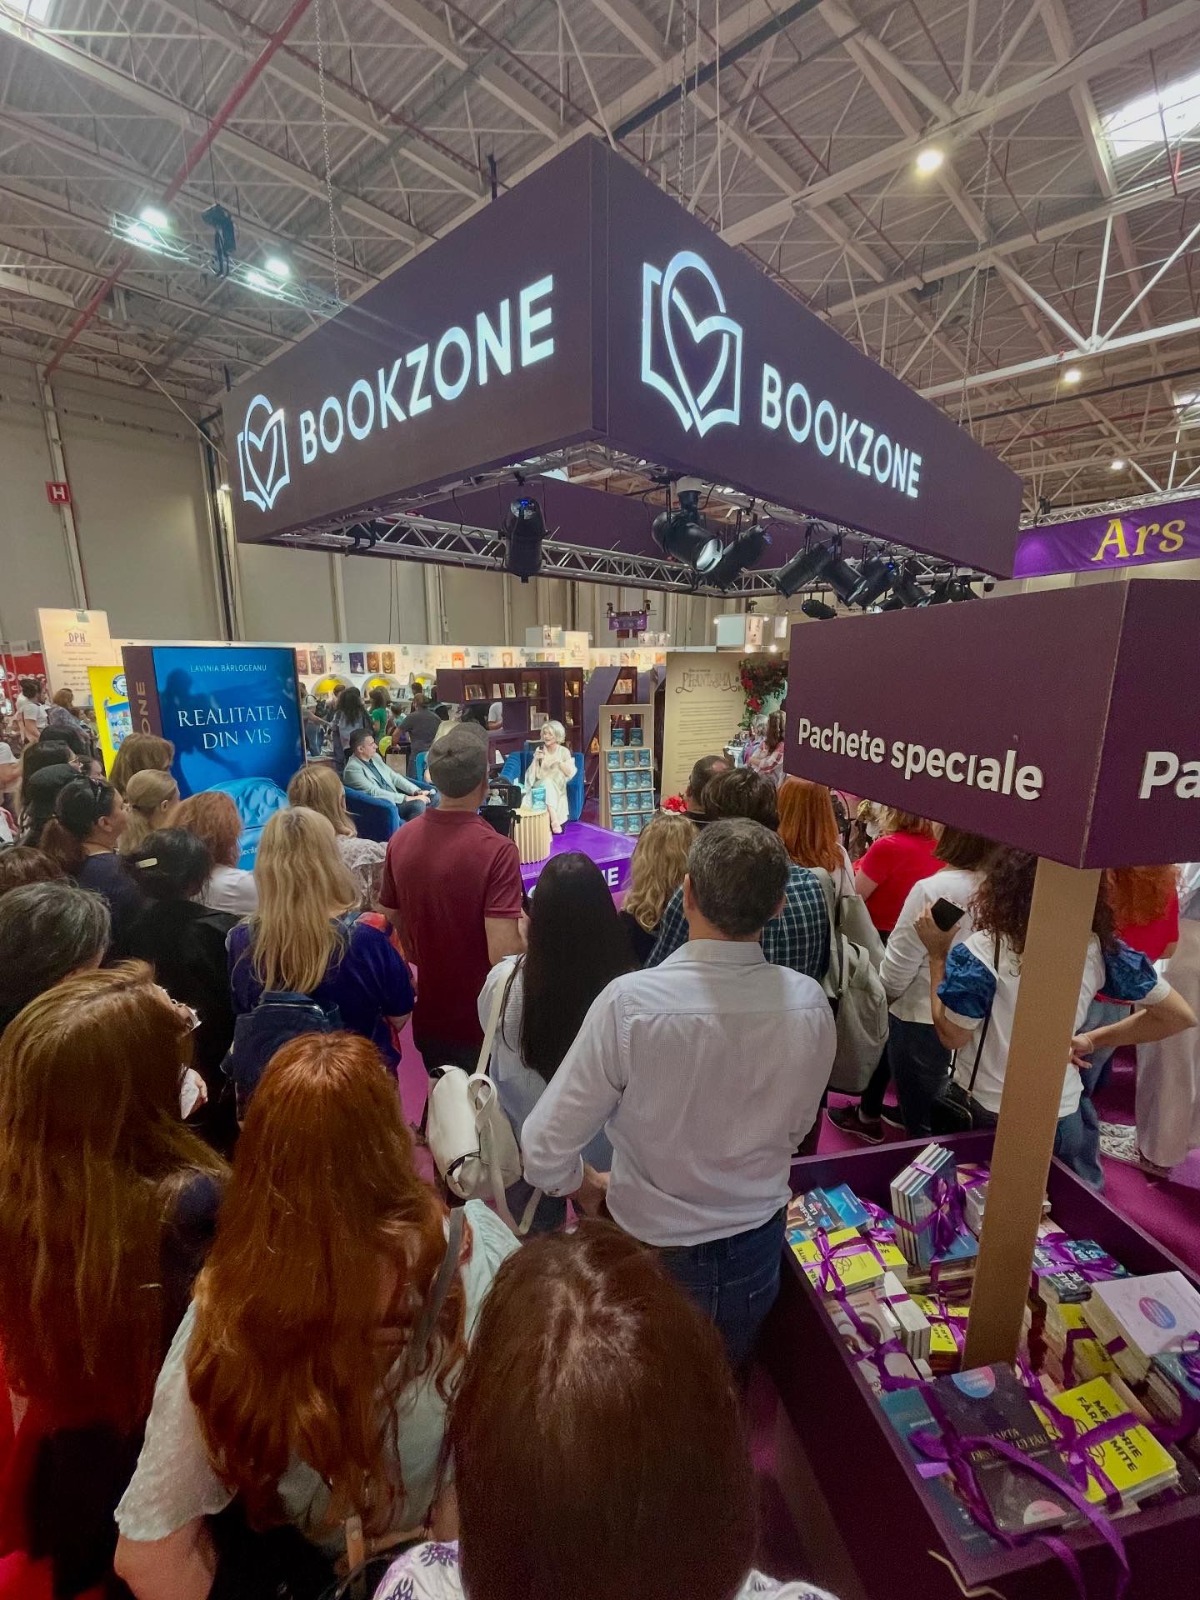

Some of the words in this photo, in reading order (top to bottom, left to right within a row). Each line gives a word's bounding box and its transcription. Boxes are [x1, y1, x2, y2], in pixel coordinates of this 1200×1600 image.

[300, 274, 554, 465] BOOKZONE
[761, 363, 922, 498] BOOKZONE
[52, 486, 66, 500] H
[1091, 518, 1186, 561] Ars
[68, 632, 86, 643] DPH
[190, 664, 219, 673] LAVINIA
[177, 705, 287, 727] REALITATEA
[202, 730, 239, 750] DIN
[245, 728, 272, 745] VIS
[798, 718, 885, 764] Pachete
[891, 740, 1043, 801] speciale
